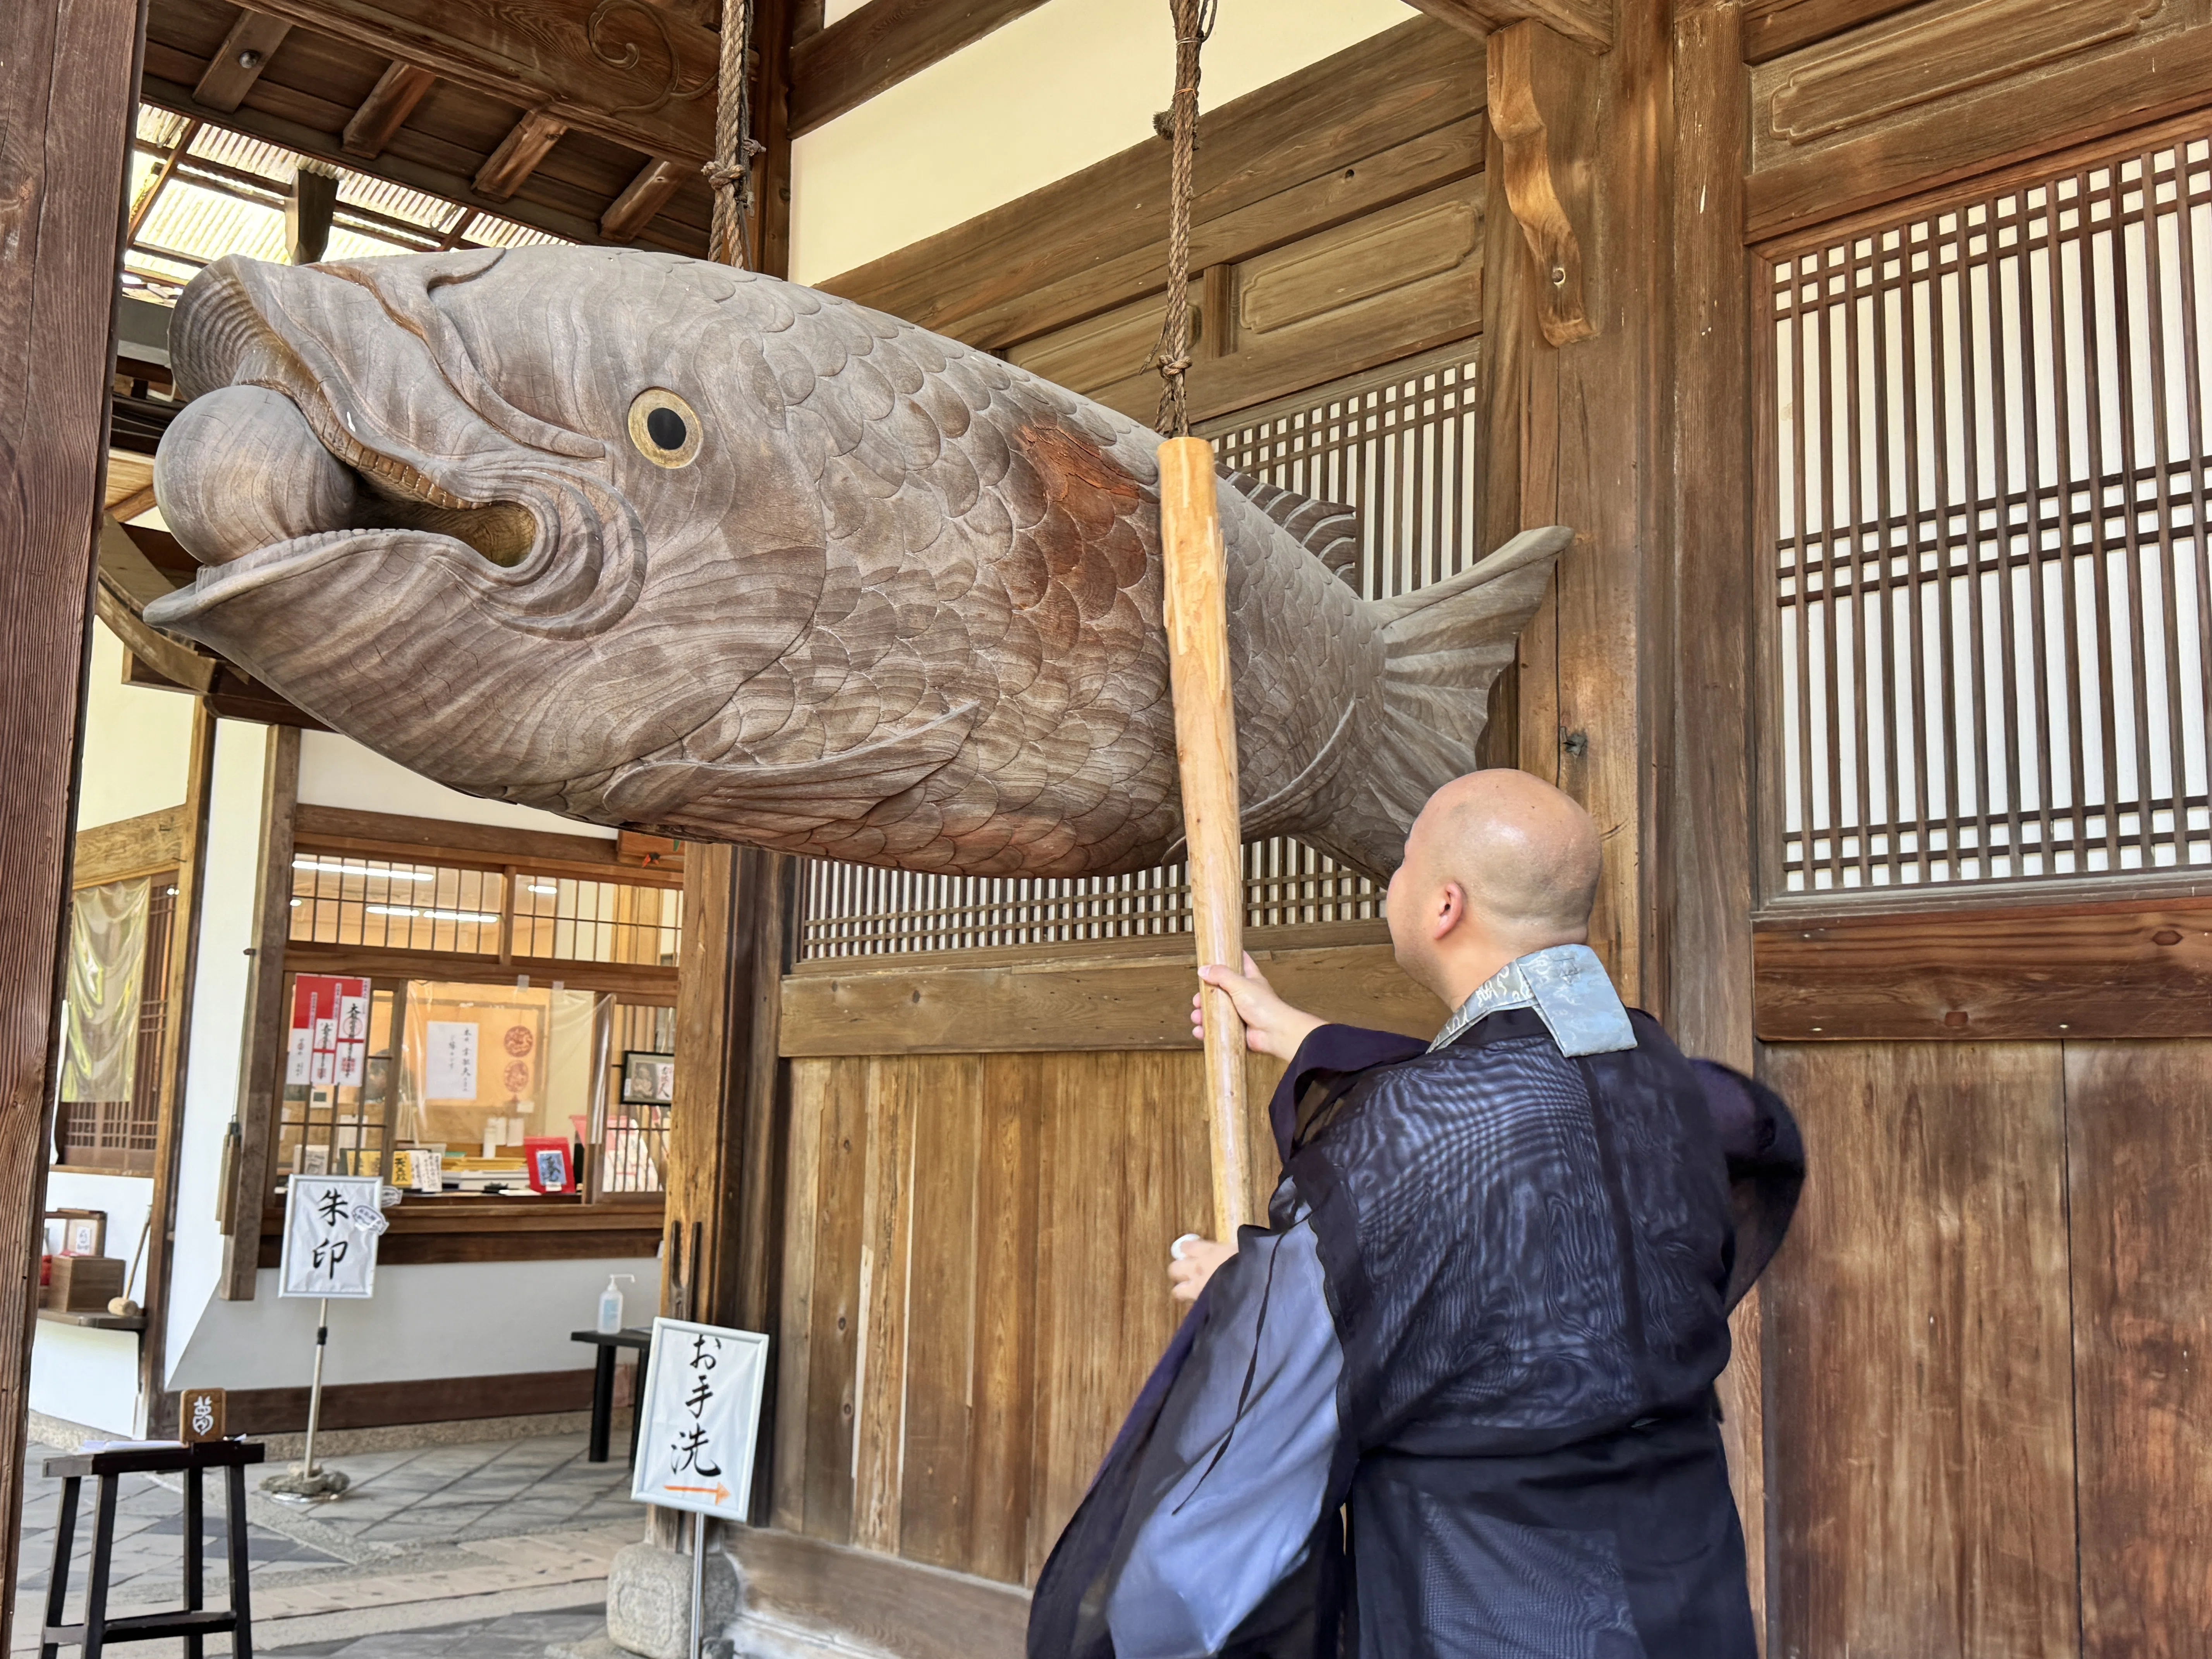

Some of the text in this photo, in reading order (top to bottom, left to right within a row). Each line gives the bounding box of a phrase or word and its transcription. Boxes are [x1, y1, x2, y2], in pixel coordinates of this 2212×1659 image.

[312, 1188, 349, 1279] 朱印
[671, 1334, 721, 1477] お手洗
